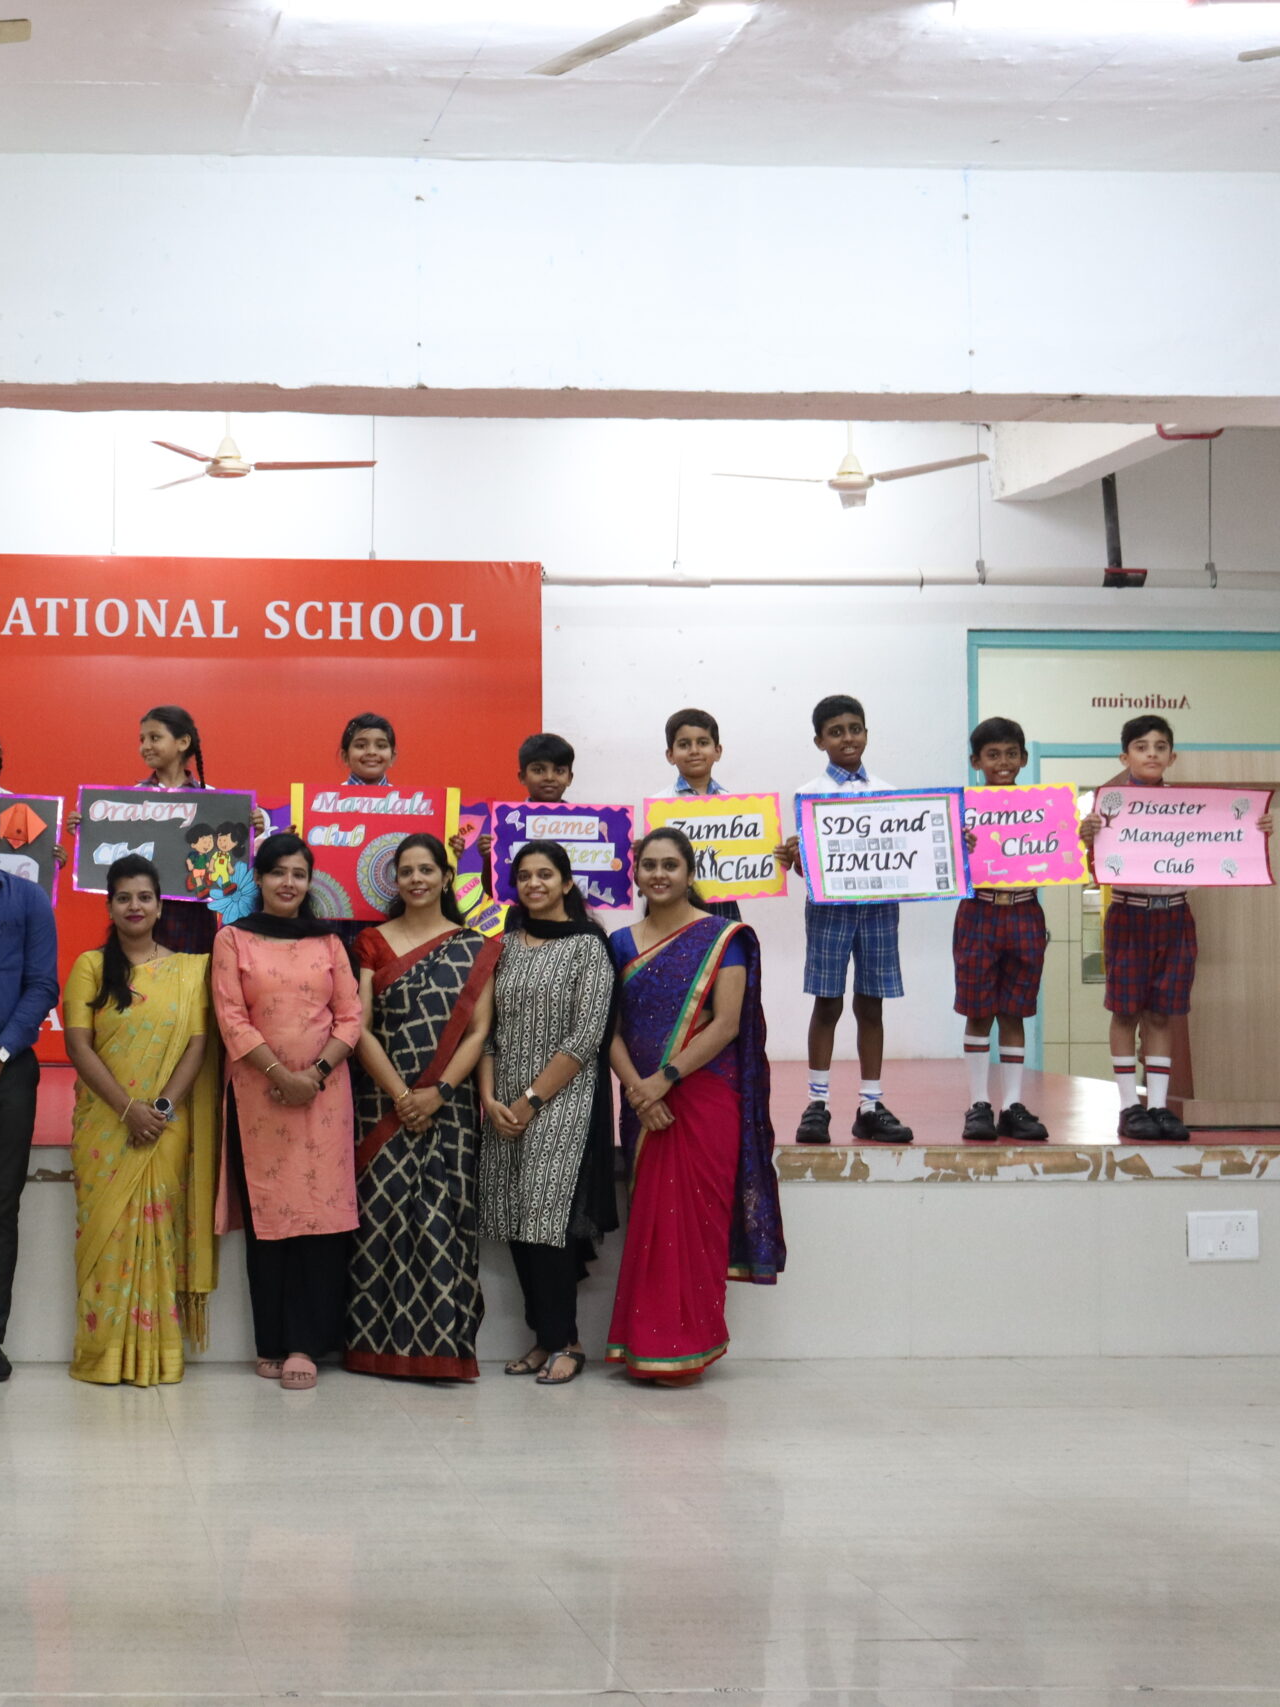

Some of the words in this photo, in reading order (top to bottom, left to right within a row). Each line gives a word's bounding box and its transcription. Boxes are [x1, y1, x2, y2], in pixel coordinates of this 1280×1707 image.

[263, 599, 477, 643] SCHOOL
[89, 800, 197, 828] Oratory
[312, 791, 434, 815] Mandala
[1128, 801, 1206, 815] Disaster
[532, 816, 595, 838] Game
[822, 815, 872, 838] SDG
[880, 810, 930, 834] and
[964, 807, 1045, 830] Games
[308, 824, 366, 847] Club
[1002, 831, 1059, 857] Club
[1119, 828, 1244, 847] Management
[718, 854, 774, 882] Club
[825, 850, 917, 872] IIMUN
[1153, 858, 1195, 874] Club
